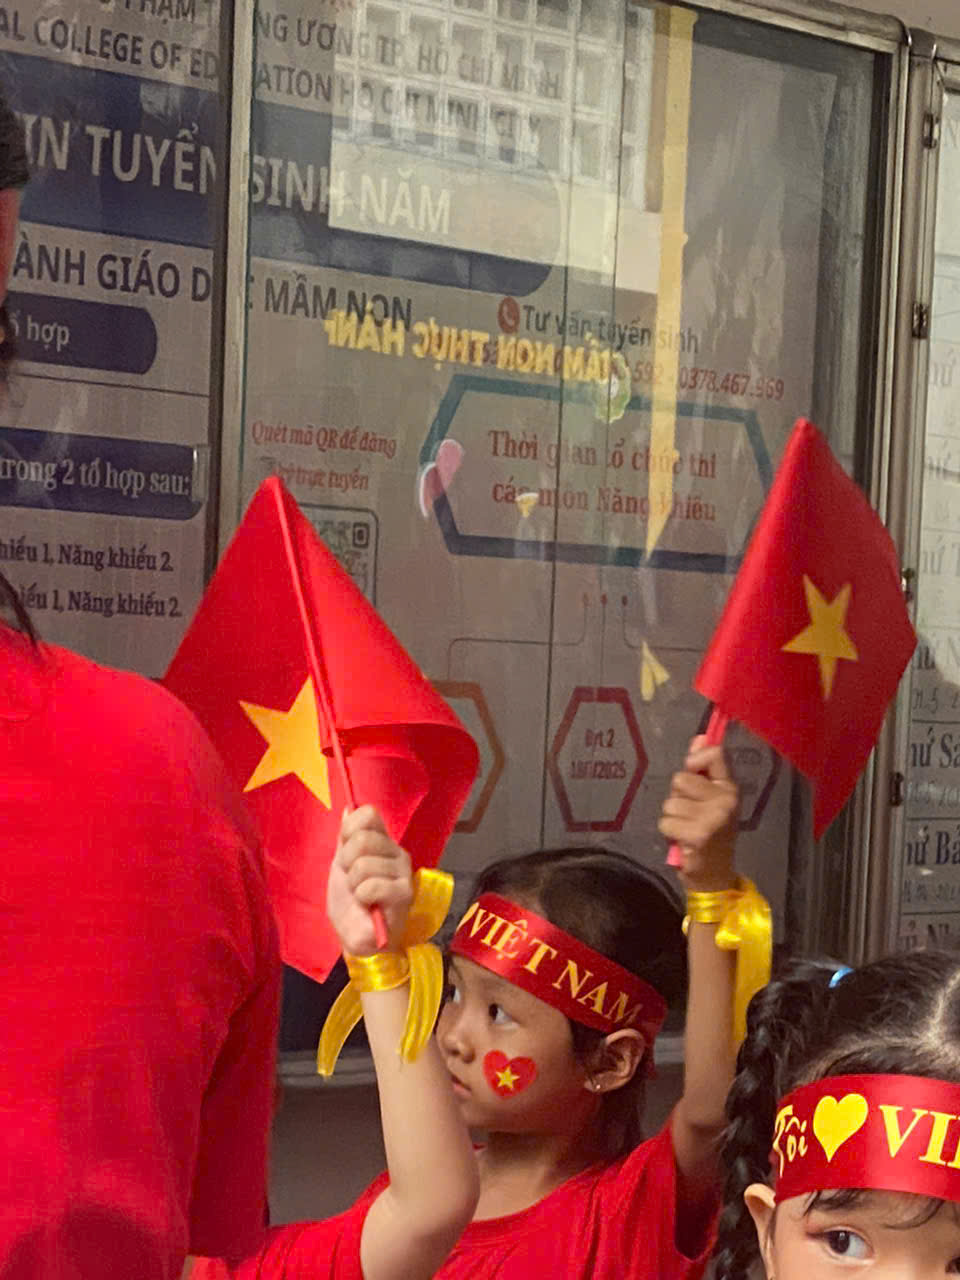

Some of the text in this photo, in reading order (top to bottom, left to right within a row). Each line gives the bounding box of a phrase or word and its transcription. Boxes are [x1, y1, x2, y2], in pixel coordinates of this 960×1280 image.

[34, 16, 143, 66] COLLEGE
[150, 40, 183, 70] OF
[250, 154, 451, 234] SINH NĂM
[97, 249, 181, 299] GIÁO
[345, 289, 413, 333] NON
[26, 315, 70, 352] hợp
[316, 427, 339, 453] QR
[488, 428, 539, 461] Thời
[61, 459, 75, 485] 2
[104, 461, 145, 499] hợp
[150, 471, 190, 496] sau:
[57, 543, 105, 572] Năng
[67, 590, 114, 618] Năng
[470, 907, 644, 1026] VIỆT NAM
